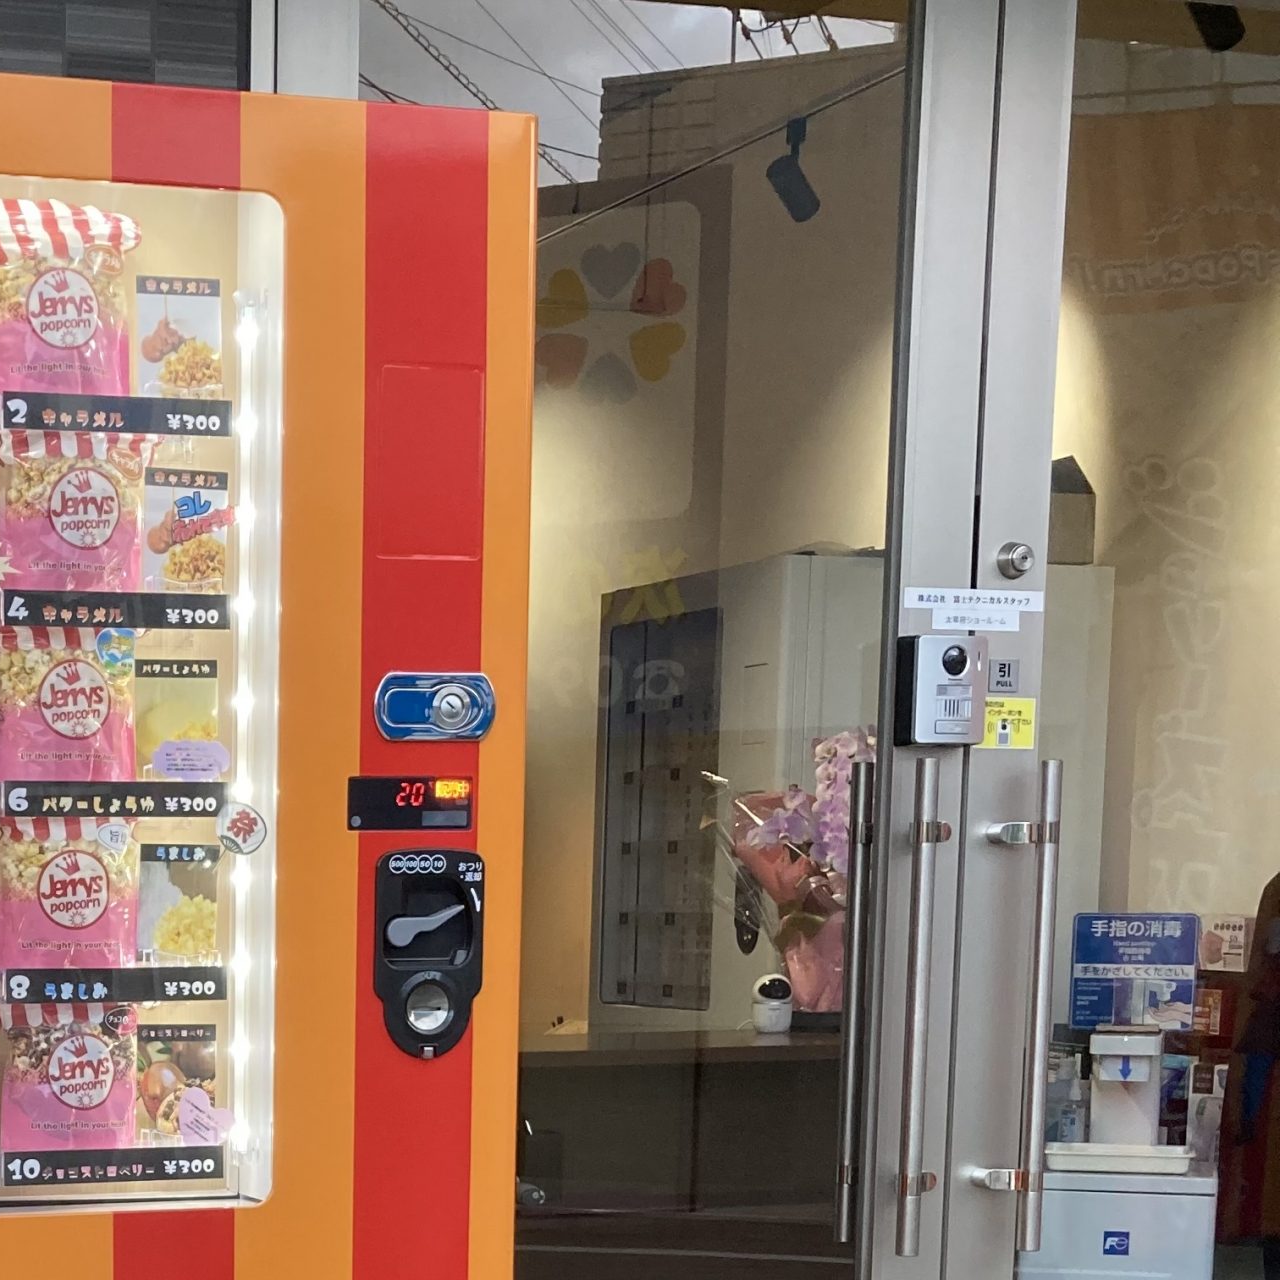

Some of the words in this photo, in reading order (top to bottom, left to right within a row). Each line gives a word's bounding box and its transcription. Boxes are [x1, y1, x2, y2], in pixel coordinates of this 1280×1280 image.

[145, 279, 211, 295] キャラメル
[40, 317, 91, 334] popcorn
[7, 399, 28, 424] 2
[41, 408, 124, 428] キャラメル
[154, 472, 220, 487] キャラメル
[174, 491, 211, 519] コレ
[60, 518, 110, 533] popcorn
[918, 594, 946, 603] 株式会社
[953, 595, 1031, 606] 富士テクニカルスタッフ
[7, 596, 29, 620] 4
[42, 605, 124, 623] キャラメル
[142, 664, 210, 675] バターしょうゆ
[998, 663, 1011, 678] 引
[996, 680, 1013, 688] PULL
[52, 710, 100, 724] popcorn
[8, 788, 28, 812] 6
[42, 796, 155, 813] バターしょうゆ
[396, 782, 425, 806] 20
[227, 809, 258, 844] 祭
[156, 847, 206, 861] うましお
[391, 860, 404, 868] 500
[405, 860, 417, 868] 100
[420, 860, 430, 868] 50
[434, 860, 443, 868] 10
[459, 862, 482, 871] おつり
[50, 898, 100, 914] popcorn
[1091, 920, 1183, 938] 手指の消毒
[10, 975, 30, 1000] 8
[44, 982, 108, 1000] うましお
[60, 1080, 107, 1096] popcorn
[8, 1158, 40, 1180] 10
